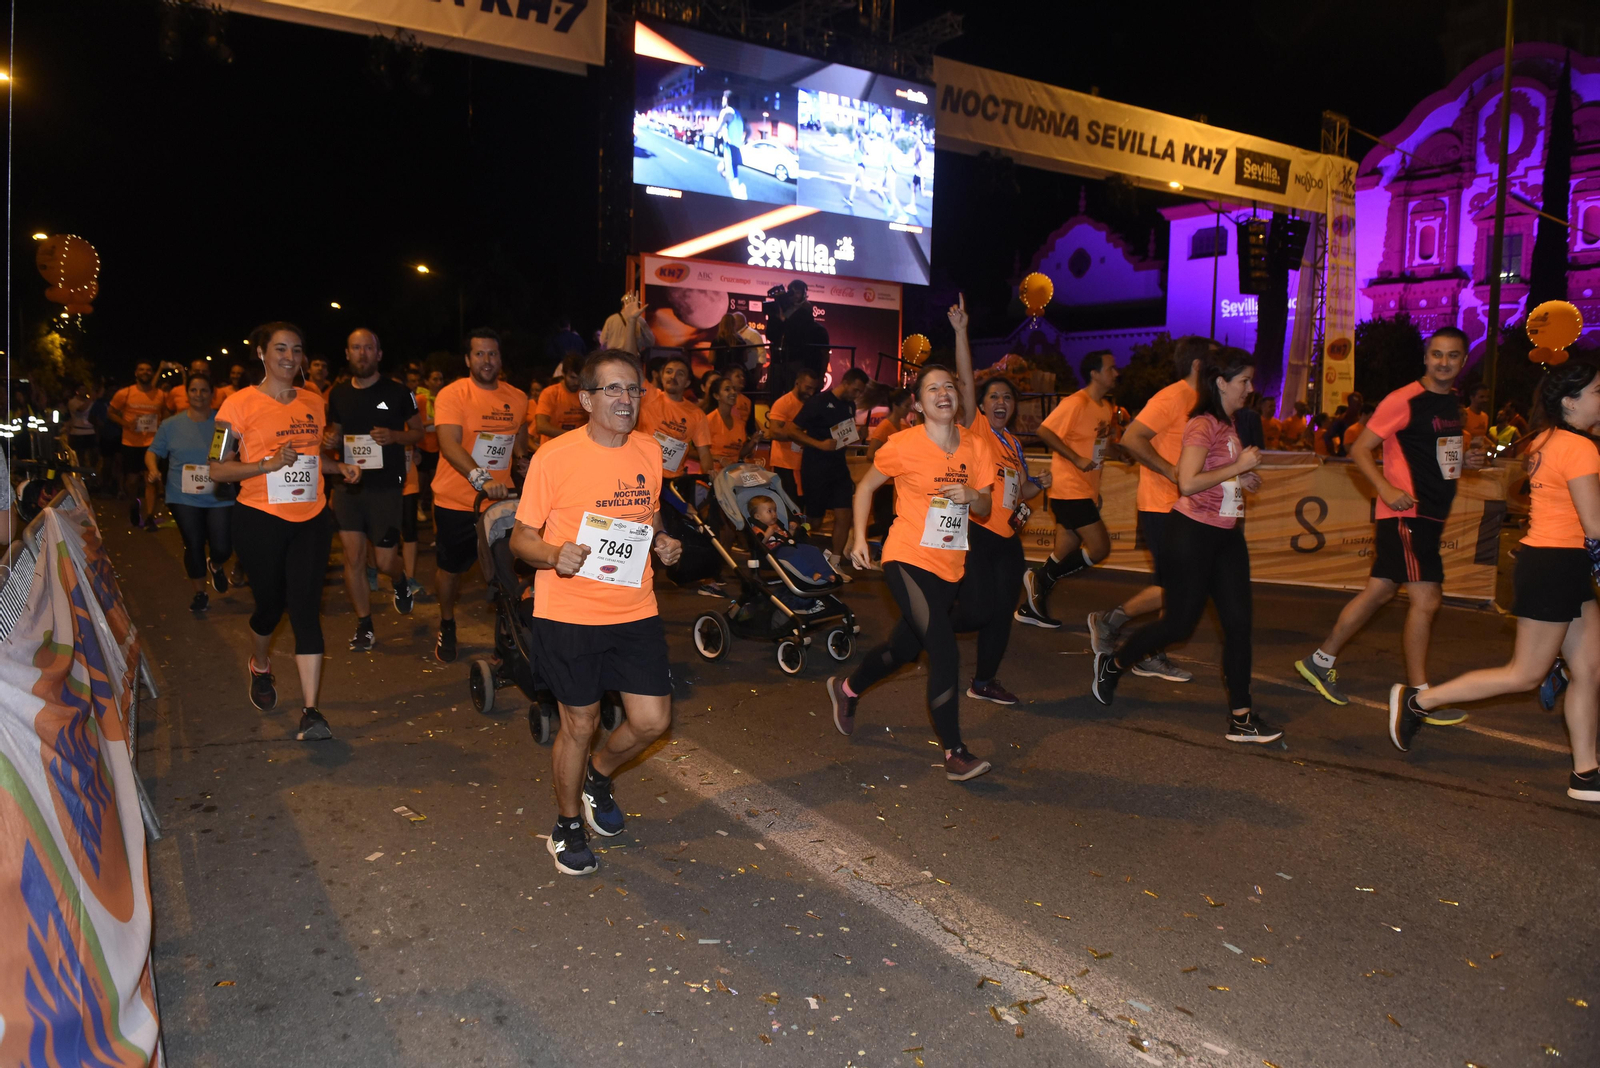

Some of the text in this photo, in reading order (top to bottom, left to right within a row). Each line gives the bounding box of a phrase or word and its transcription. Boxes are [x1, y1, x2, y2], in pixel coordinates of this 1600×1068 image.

[941, 84, 1079, 141] NOCTURNA
[1085, 120, 1175, 163] SEVILLA
[276, 428, 305, 437] SEVILLA
[352, 446, 372, 456] 6229
[486, 445, 506, 456] 7840
[1444, 450, 1459, 462] 7592
[284, 471, 311, 483] 6228
[614, 490, 651, 498] NOCTURNA
[595, 499, 633, 508] SEVILLA
[940, 515, 962, 529] 7844
[598, 538, 633, 559] 7849
